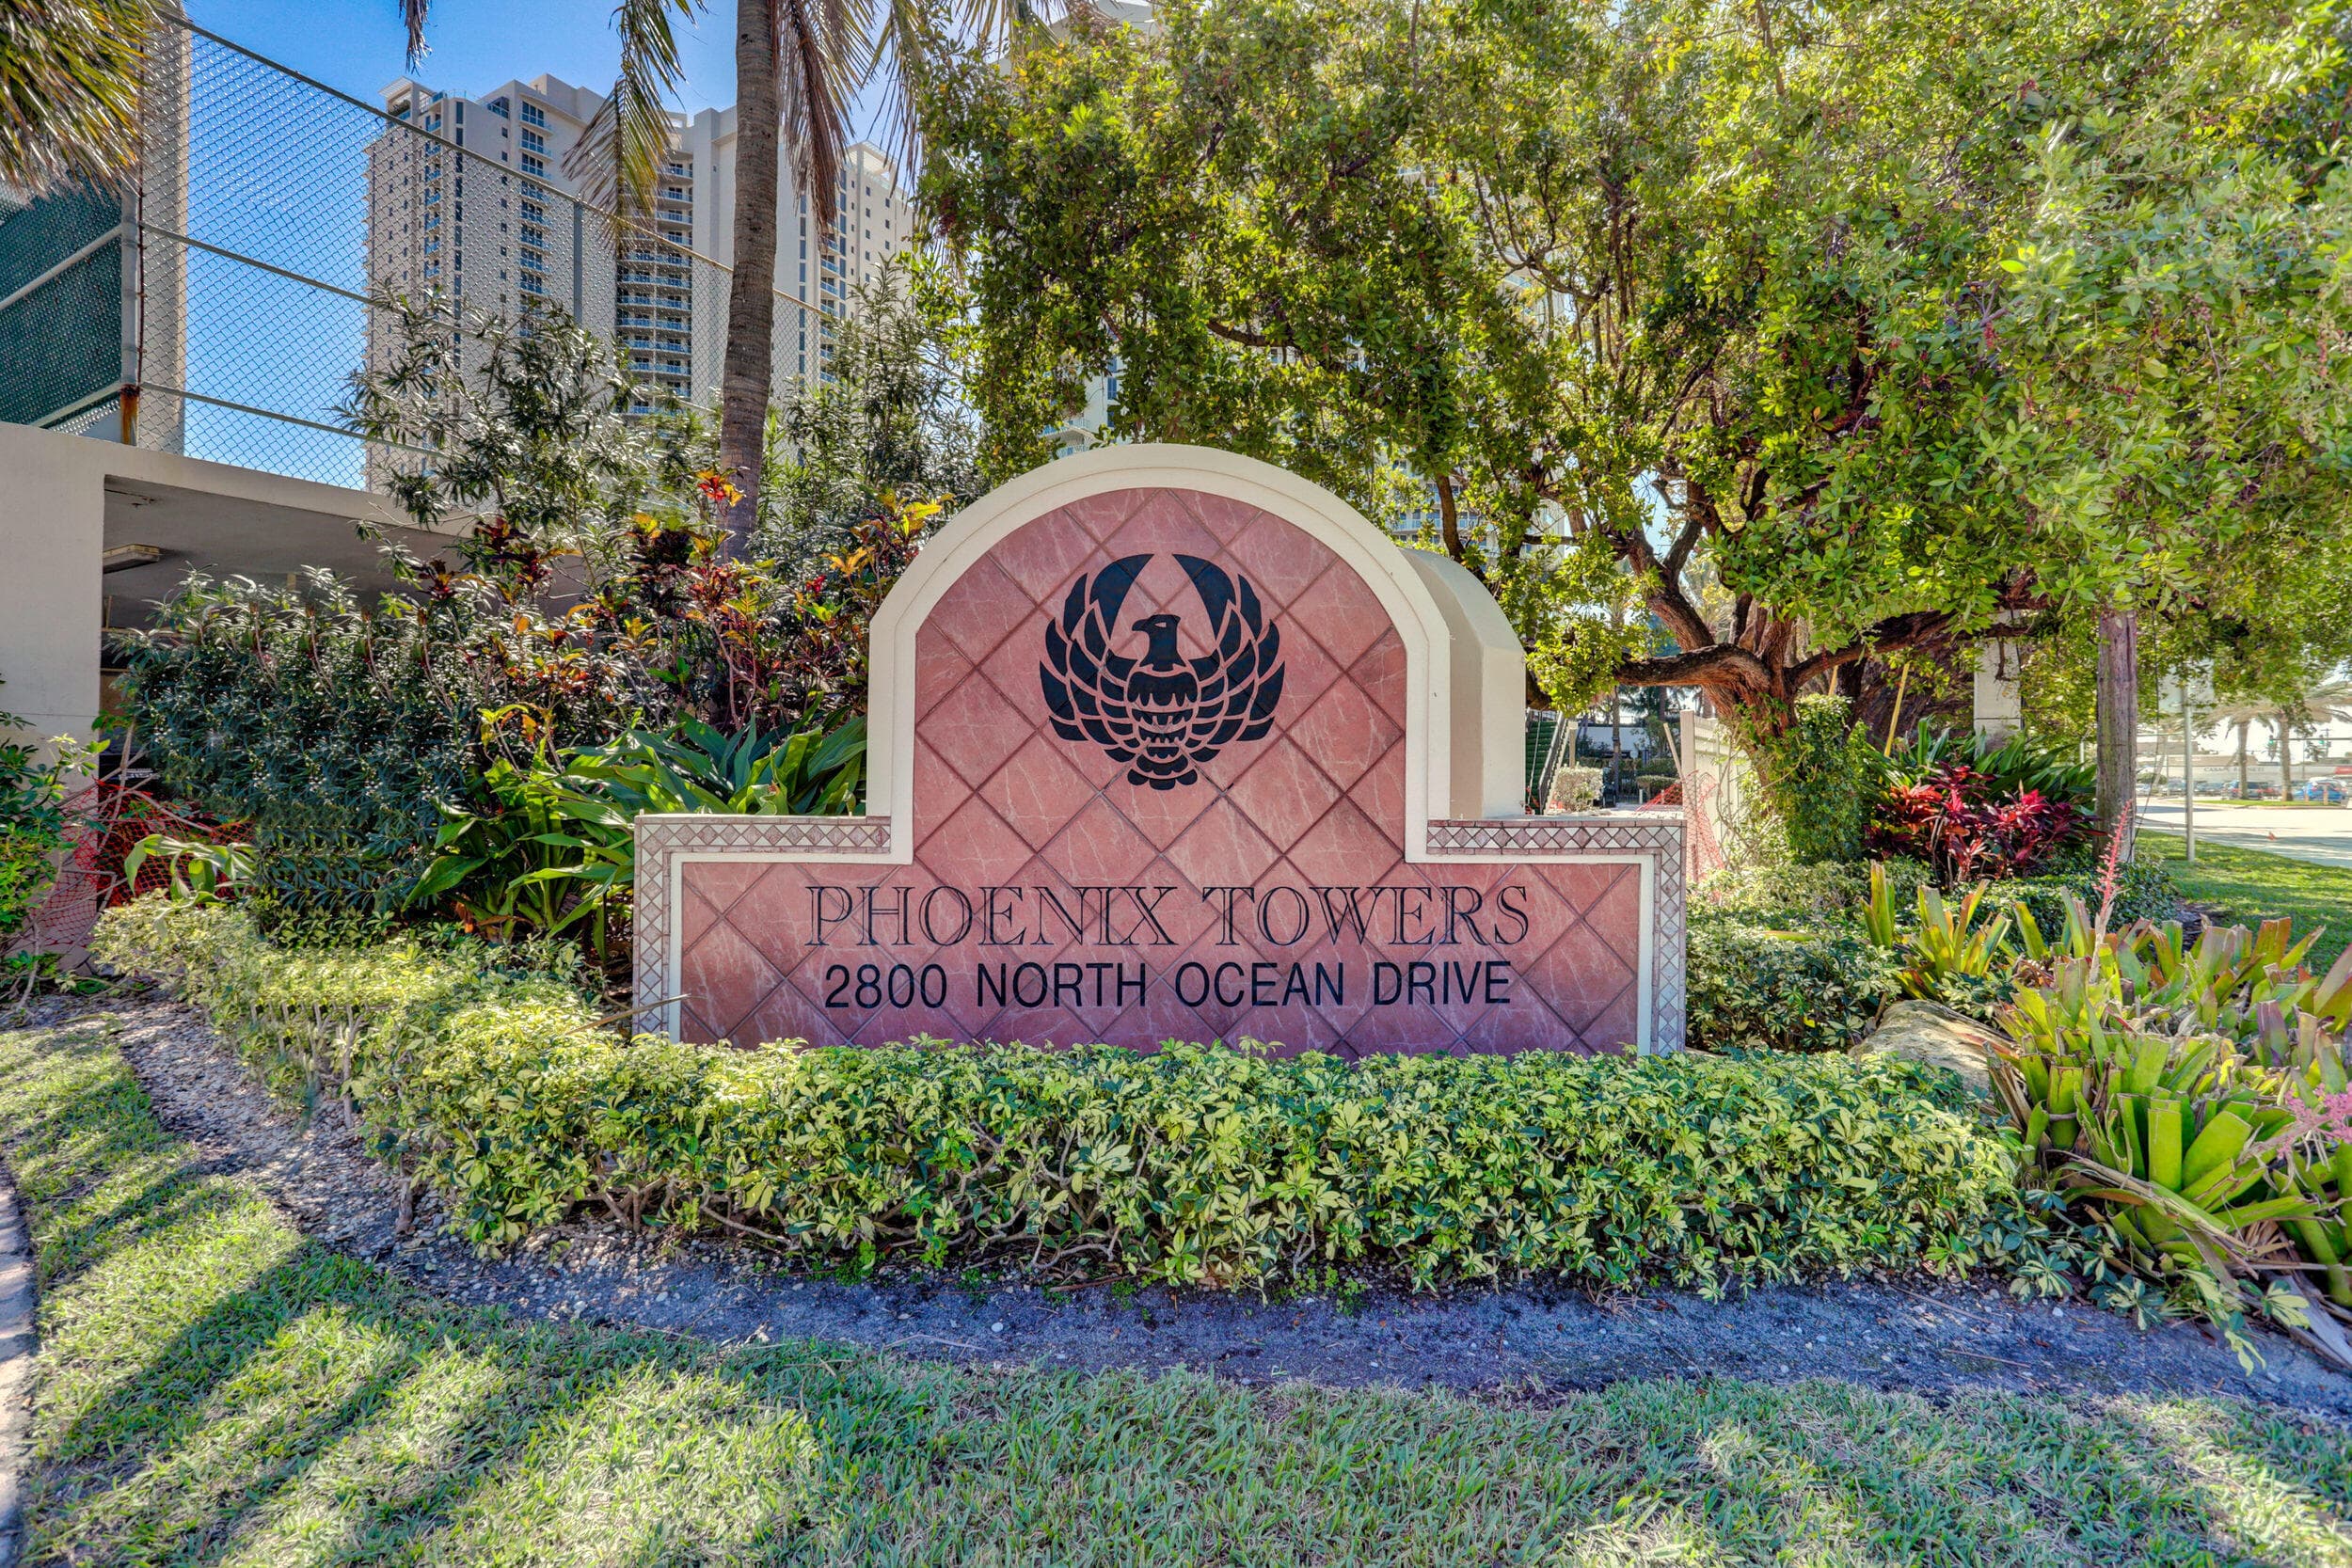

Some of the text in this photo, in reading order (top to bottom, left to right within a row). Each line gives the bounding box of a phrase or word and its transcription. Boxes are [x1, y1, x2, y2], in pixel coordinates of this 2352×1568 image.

[806, 885, 1530, 946] PHOENIX TOWERS
[824, 960, 1512, 1009] 2800 NORTH OCEAN DRIVE
